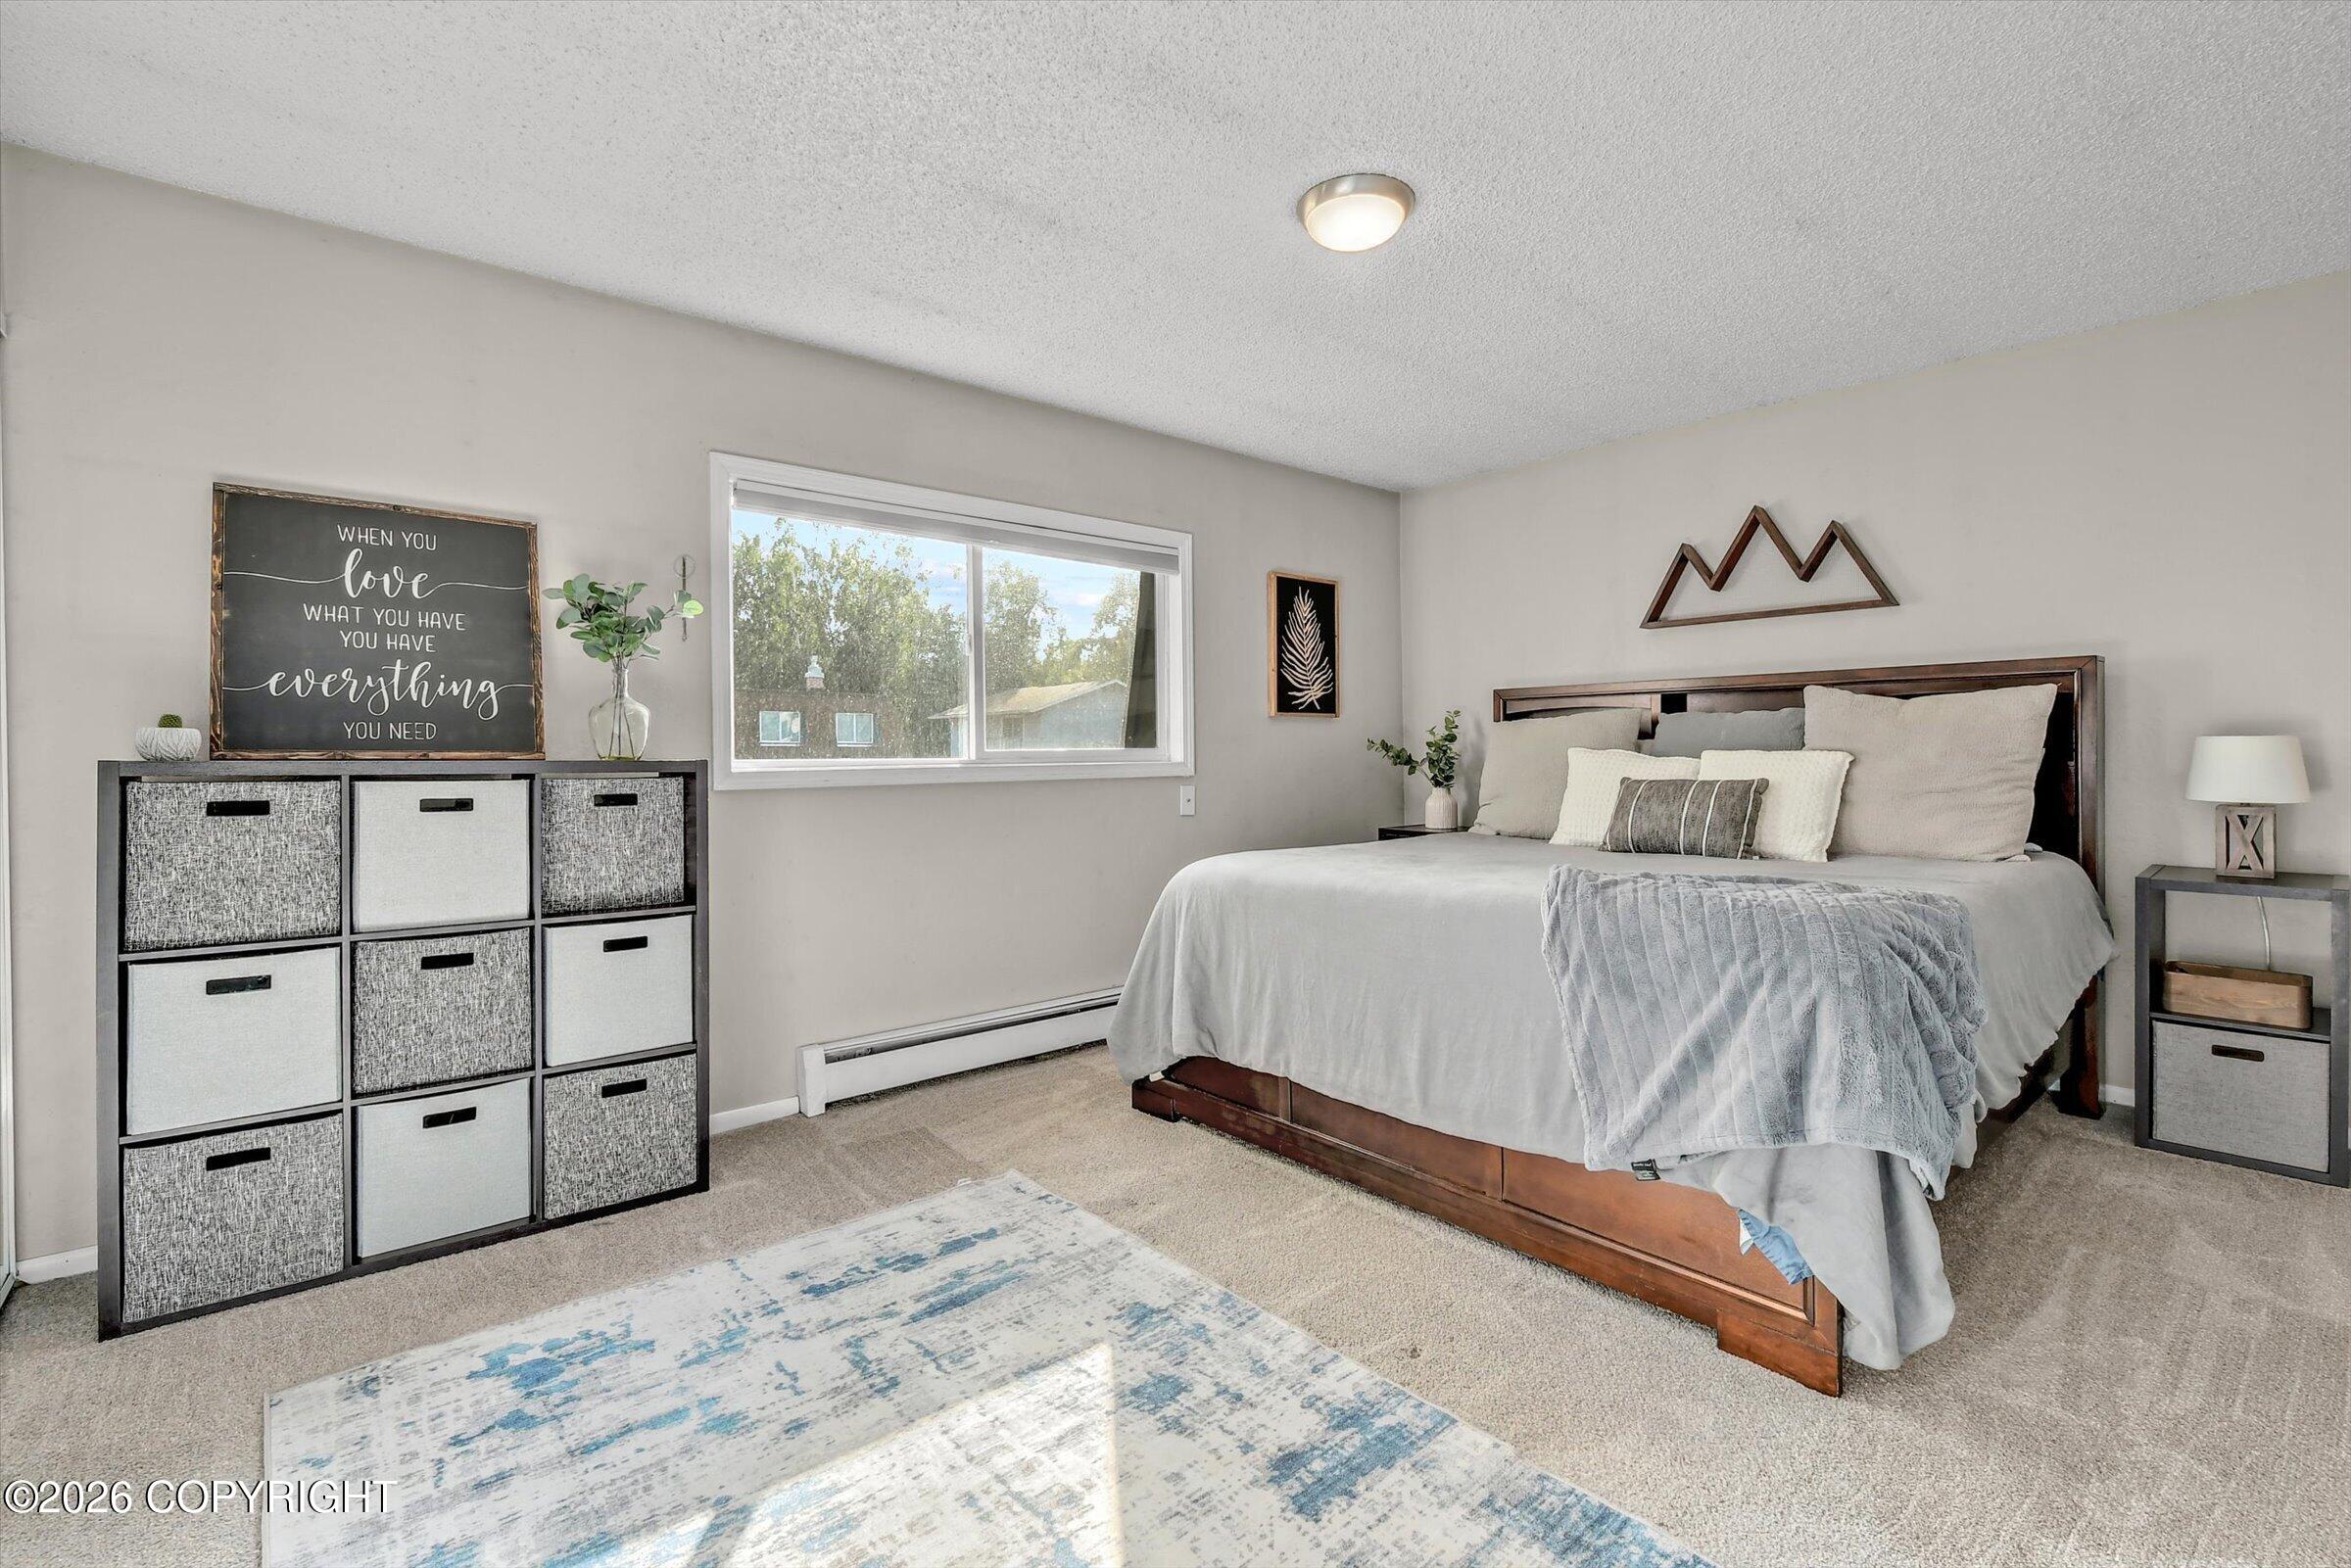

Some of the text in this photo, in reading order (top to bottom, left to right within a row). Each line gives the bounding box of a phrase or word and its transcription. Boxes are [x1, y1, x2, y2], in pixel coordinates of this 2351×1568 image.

[337, 524, 437, 550] WHEN YOU
[343, 547, 432, 599] love
[303, 602, 465, 631] WHAT YOU HAVE
[340, 630, 437, 652] YOU HAVE
[266, 658, 500, 721] everything
[343, 722, 437, 740] YOU NEED
